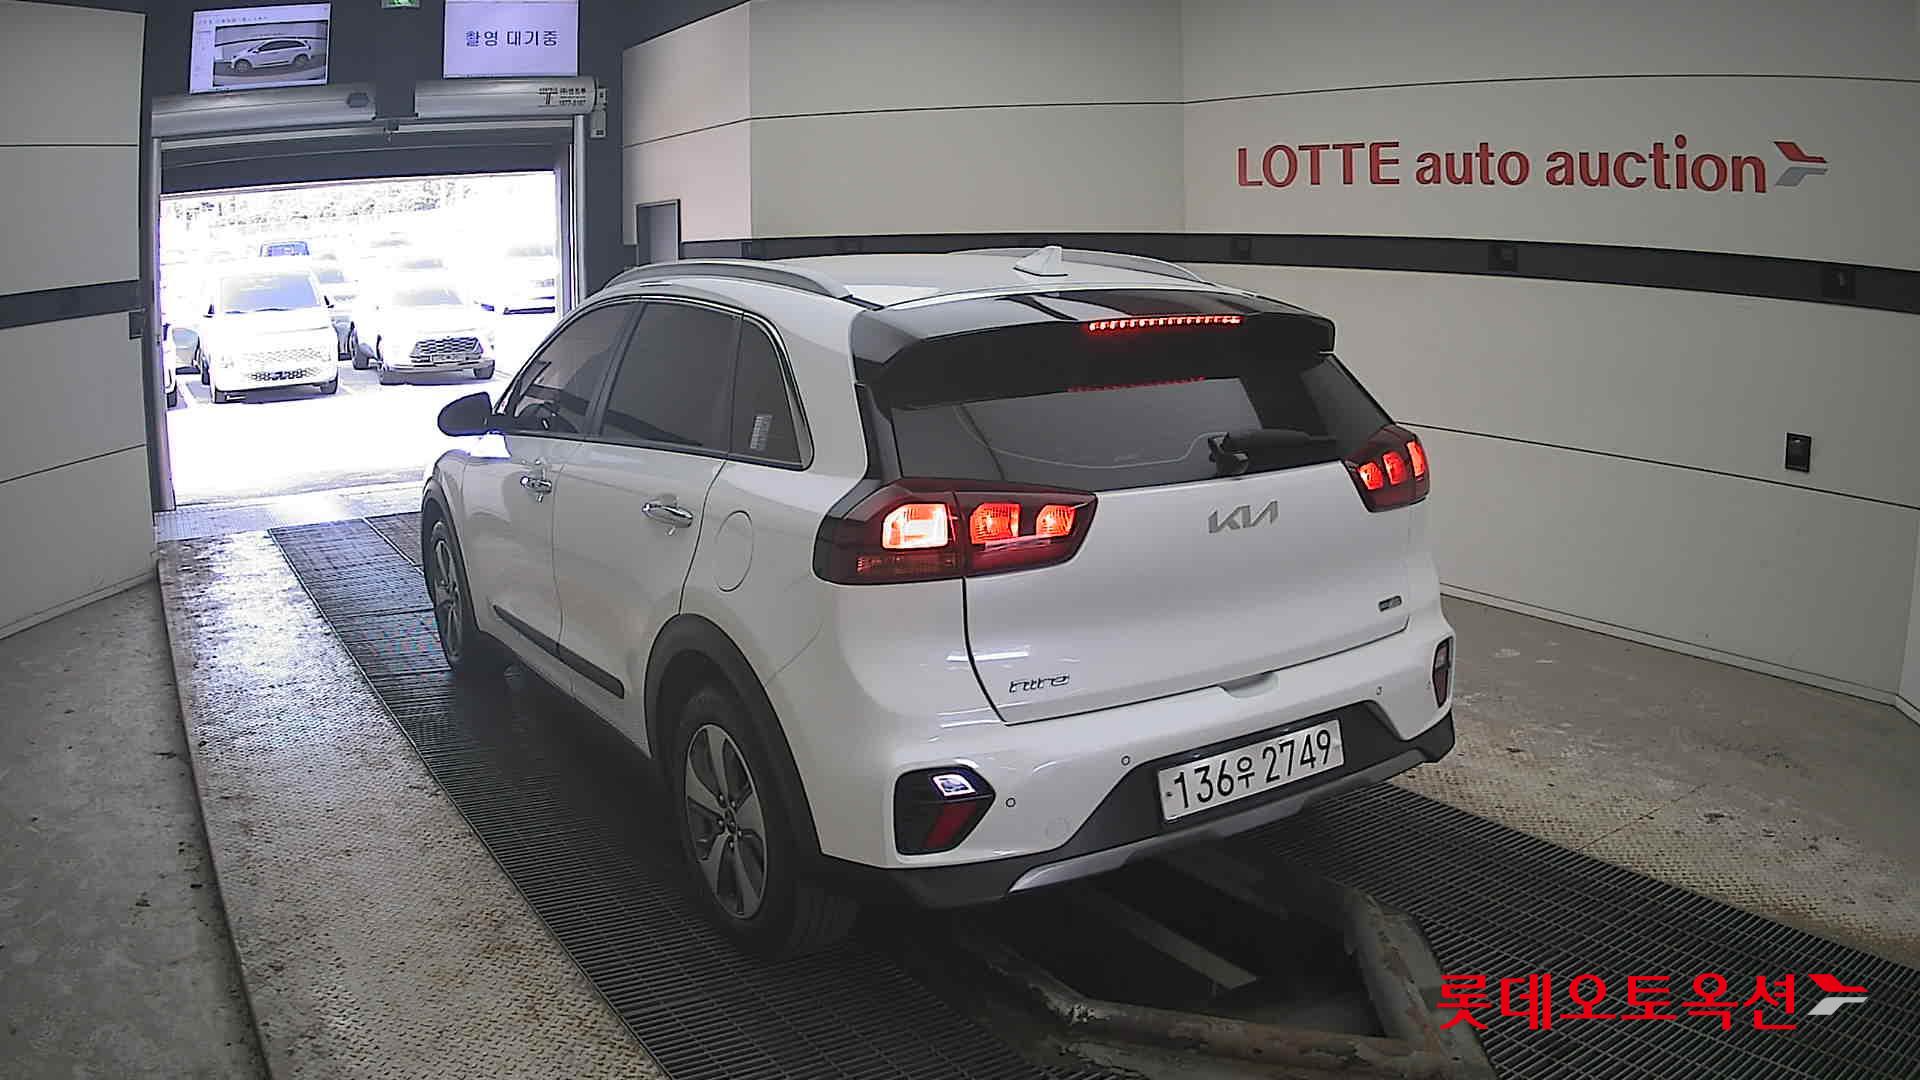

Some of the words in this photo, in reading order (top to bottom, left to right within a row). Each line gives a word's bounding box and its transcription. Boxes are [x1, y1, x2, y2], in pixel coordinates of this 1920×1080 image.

[506, 30, 558, 47] 대기중
[1237, 141, 1399, 187] LOTTE
[1415, 141, 1530, 186] auto
[1546, 134, 1767, 193] auction
